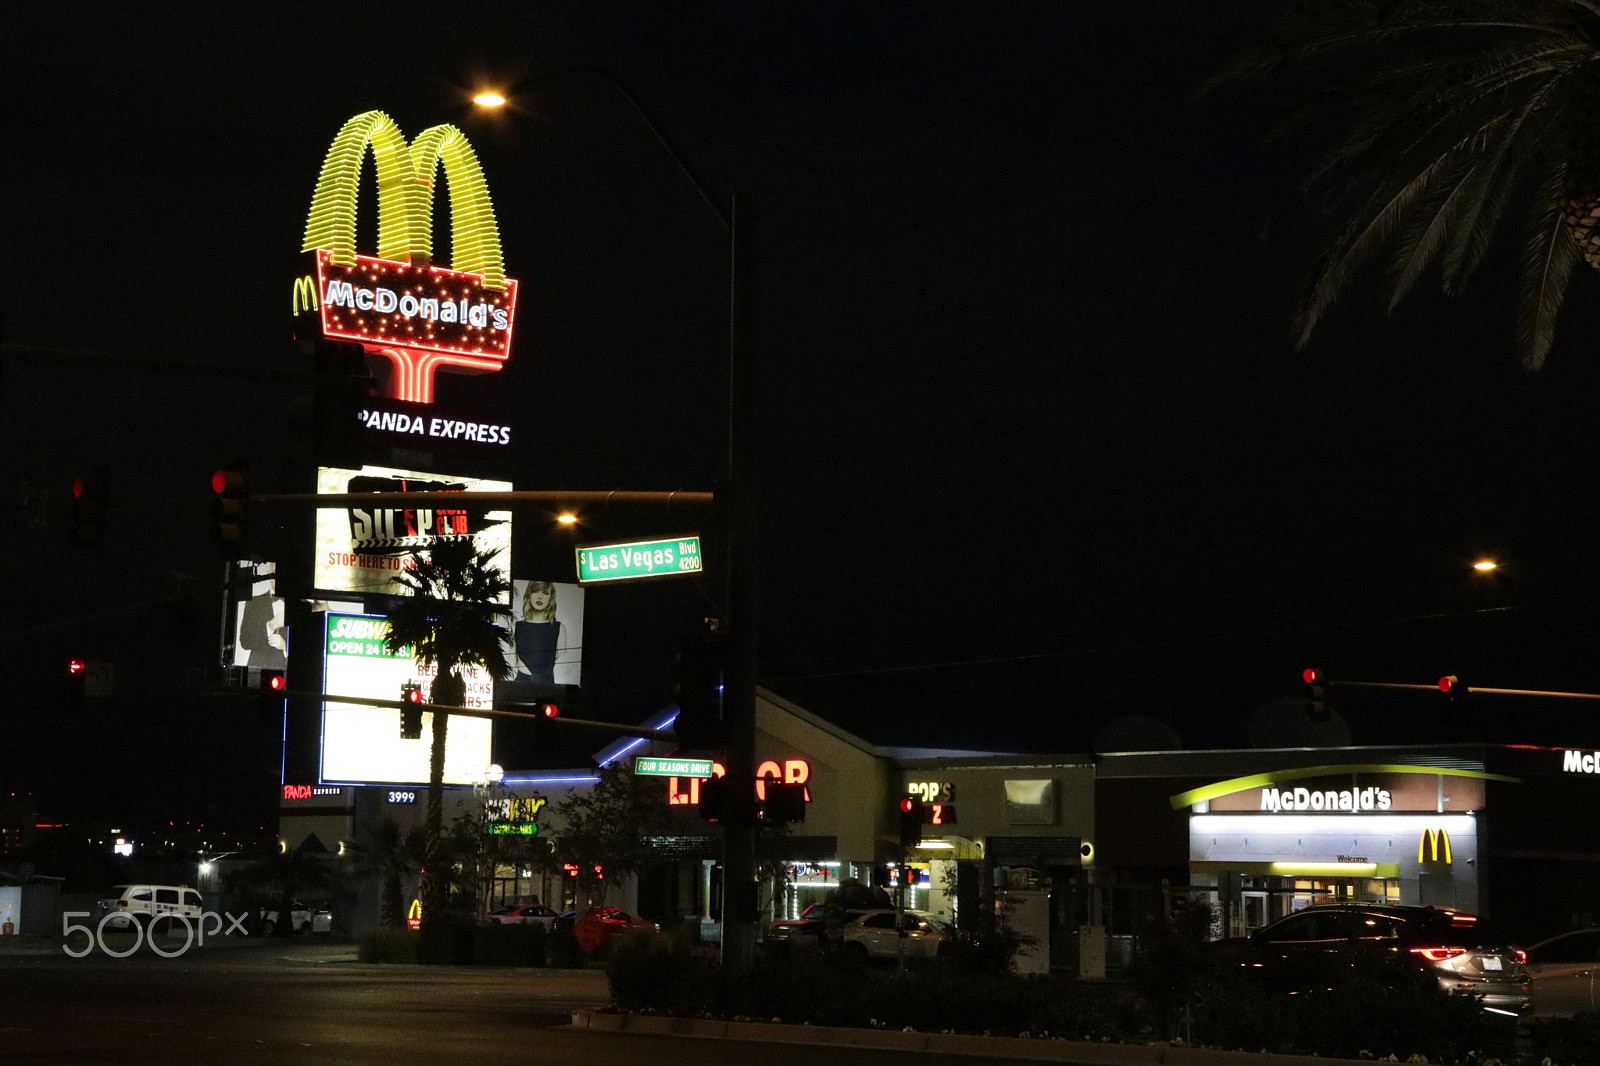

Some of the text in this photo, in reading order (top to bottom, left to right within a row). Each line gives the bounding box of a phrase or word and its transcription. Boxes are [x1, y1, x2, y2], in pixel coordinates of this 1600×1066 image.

[325, 280, 508, 330] McDonald's
[429, 417, 511, 445] EXPRESS
[329, 552, 356, 566] STOP
[358, 556, 384, 569] HERE
[386, 559, 400, 571] TO
[580, 541, 697, 572] S Las Vegas Blvd
[678, 556, 700, 571] 4200
[329, 640, 364, 655] OPEN
[365, 643, 380, 656] 24
[638, 761, 711, 774] FOUR SEASONS DRIVE
[284, 785, 312, 800] PANDA
[388, 791, 415, 803] 3999
[1261, 787, 1391, 811] McDonald's
[1336, 854, 1368, 863] Welcome
